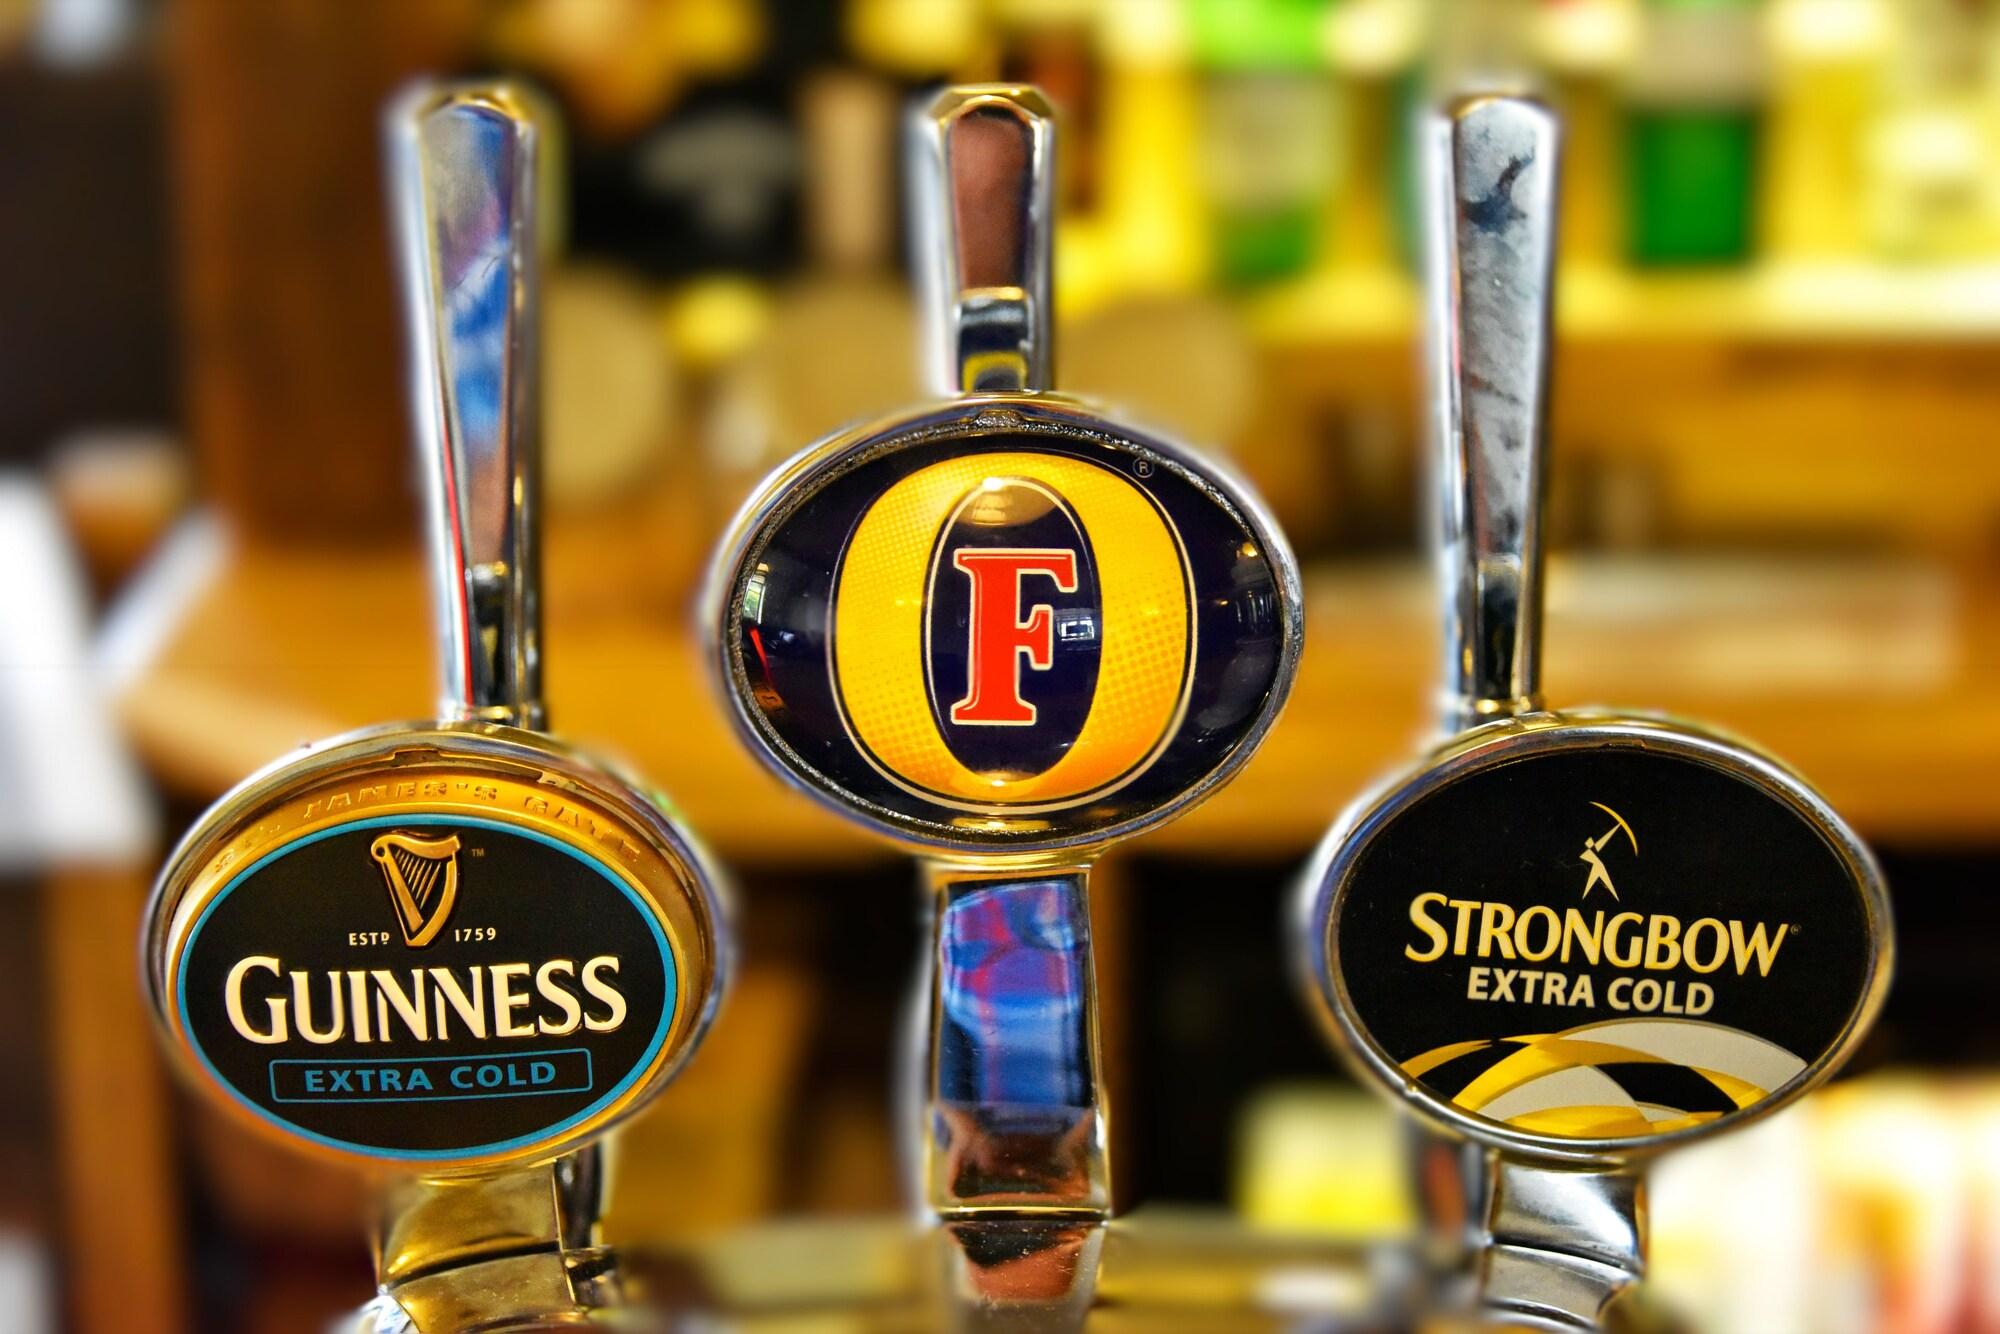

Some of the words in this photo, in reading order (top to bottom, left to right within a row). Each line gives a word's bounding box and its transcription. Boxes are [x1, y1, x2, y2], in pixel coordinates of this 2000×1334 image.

[951, 547, 1078, 726] F
[454, 927, 497, 942] 1759
[1404, 892, 1789, 977] STRONGBOW
[224, 955, 627, 1044] GUINNESS
[1466, 966, 1595, 1008] EXTRA
[1607, 976, 1715, 1016] COLD
[304, 1068, 433, 1092] EXTRA
[450, 1061, 557, 1088] COLD
